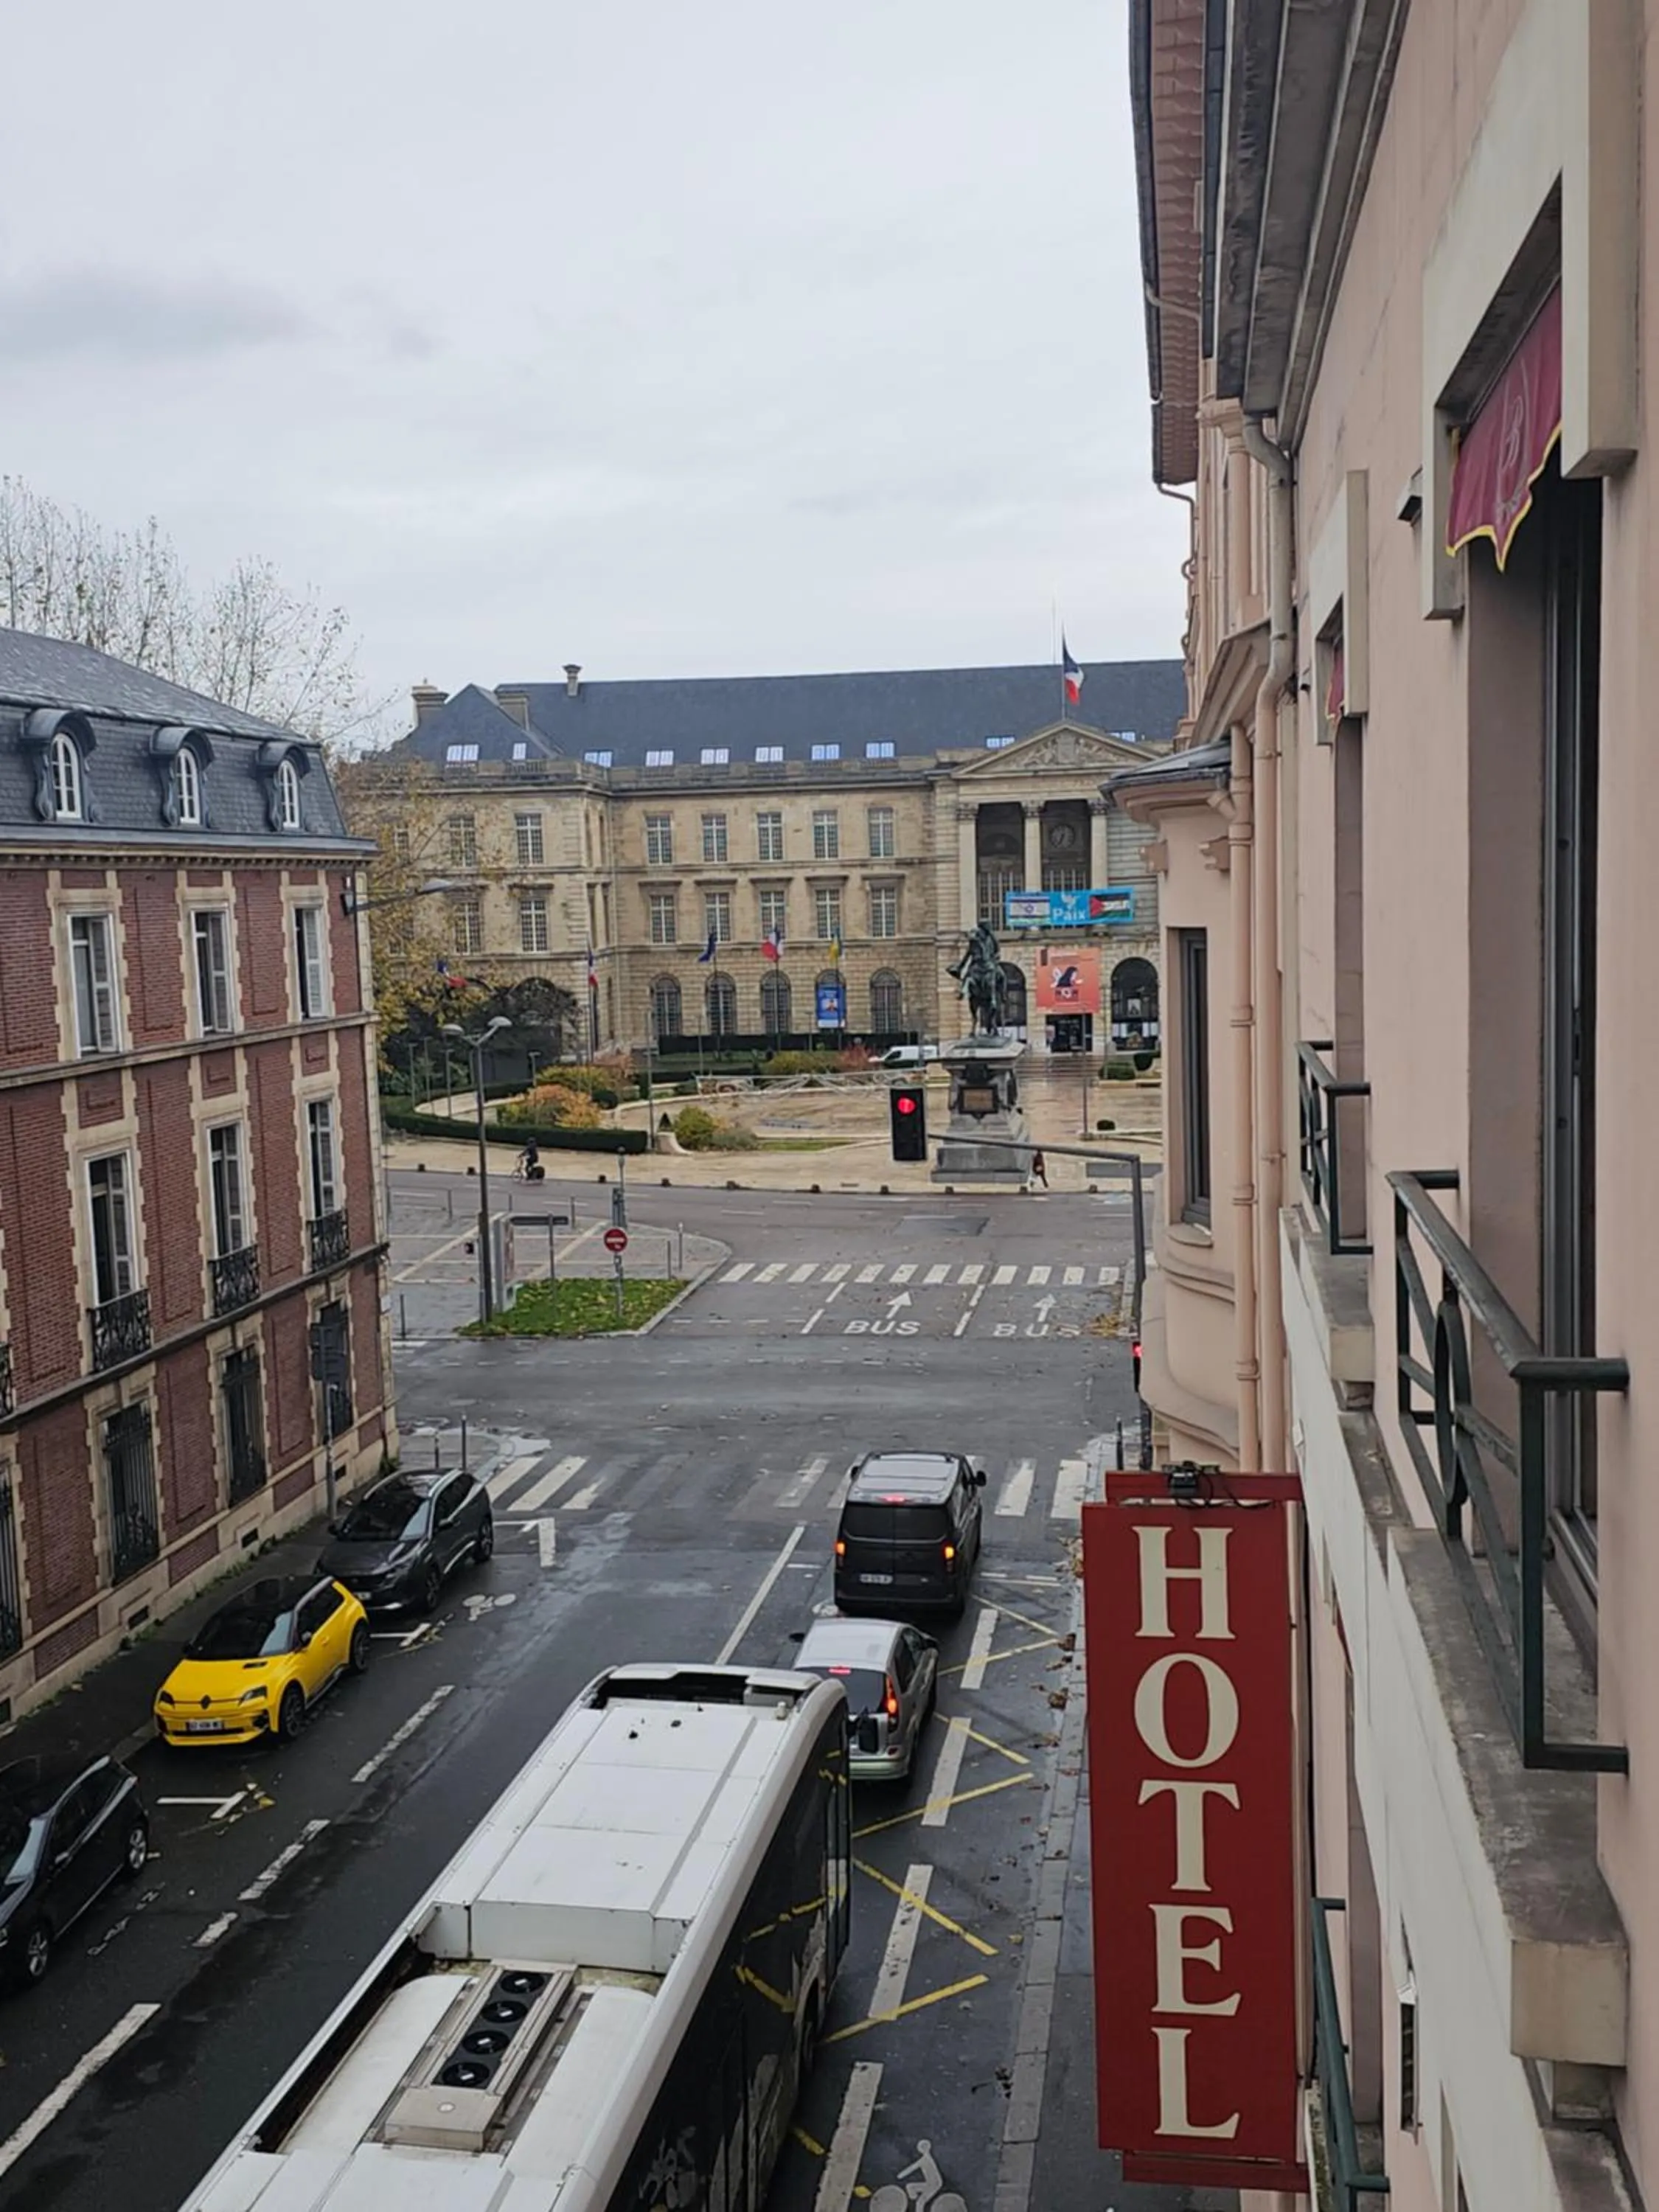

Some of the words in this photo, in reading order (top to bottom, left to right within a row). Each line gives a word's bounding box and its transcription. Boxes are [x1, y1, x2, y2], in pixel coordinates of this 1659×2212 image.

[1052, 907, 1086, 921] Paix
[844, 1320, 921, 1335] BUS
[992, 1324, 1081, 1338] BUS
[1133, 1526, 1240, 2138] HOTEL
